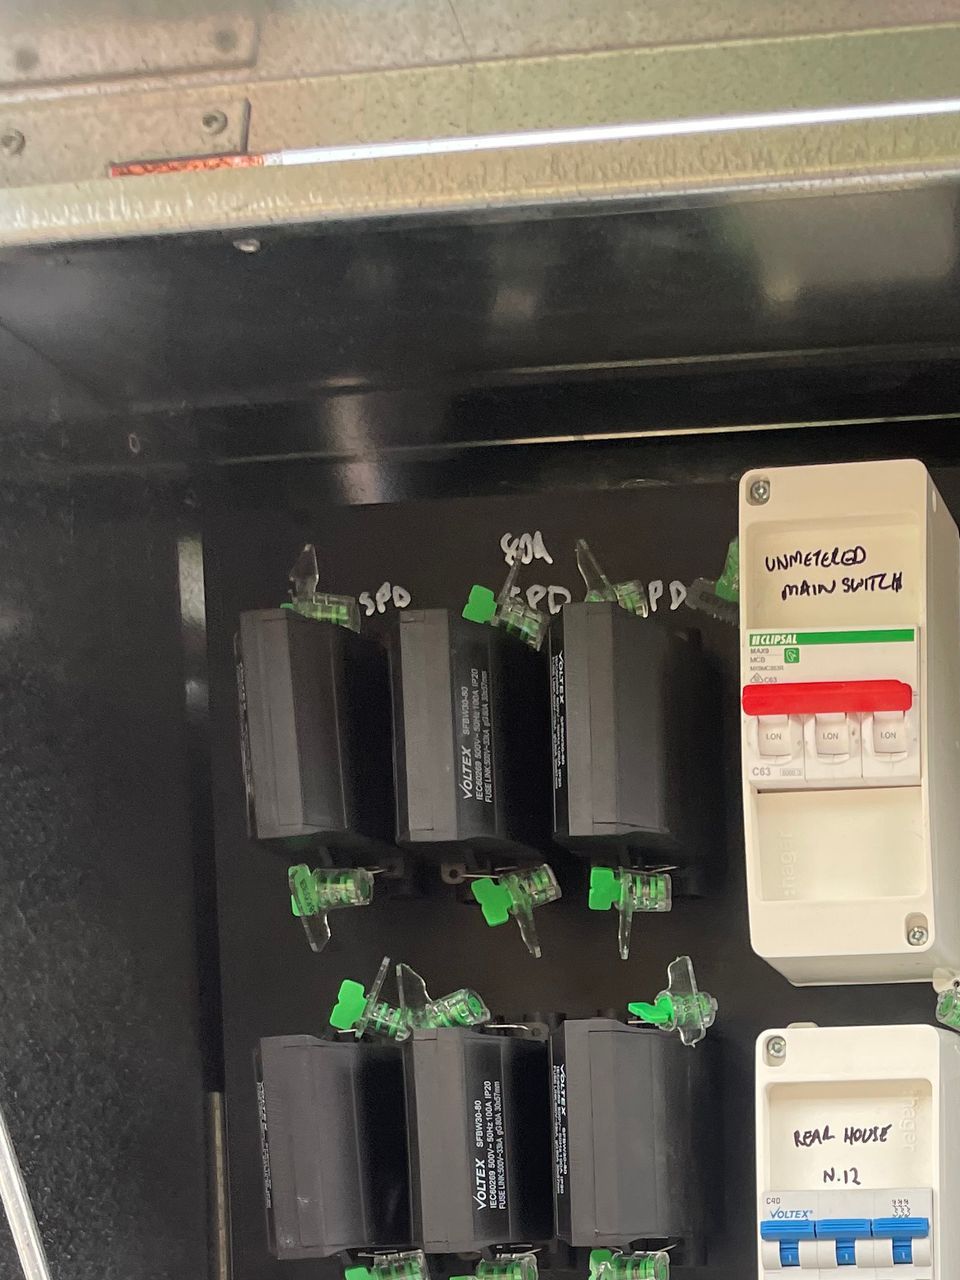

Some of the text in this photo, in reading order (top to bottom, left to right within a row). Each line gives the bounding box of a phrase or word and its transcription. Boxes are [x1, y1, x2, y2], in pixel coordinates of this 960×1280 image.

[765, 546, 866, 571] UNMETERED
[782, 572, 903, 600] MAIN SWITCH
[359, 582, 411, 616] SPD
[760, 634, 798, 645] CLIPSAL
[459, 745, 473, 799] VOLTEX
[752, 766, 771, 777] C63
[483, 1081, 492, 1099] IP20
[793, 1124, 892, 1148] REAR HOUSE
[473, 1100, 487, 1210] VOLTEX SFBW30-80
[823, 1167, 861, 1185] N.12
[766, 1197, 781, 1205] C40
